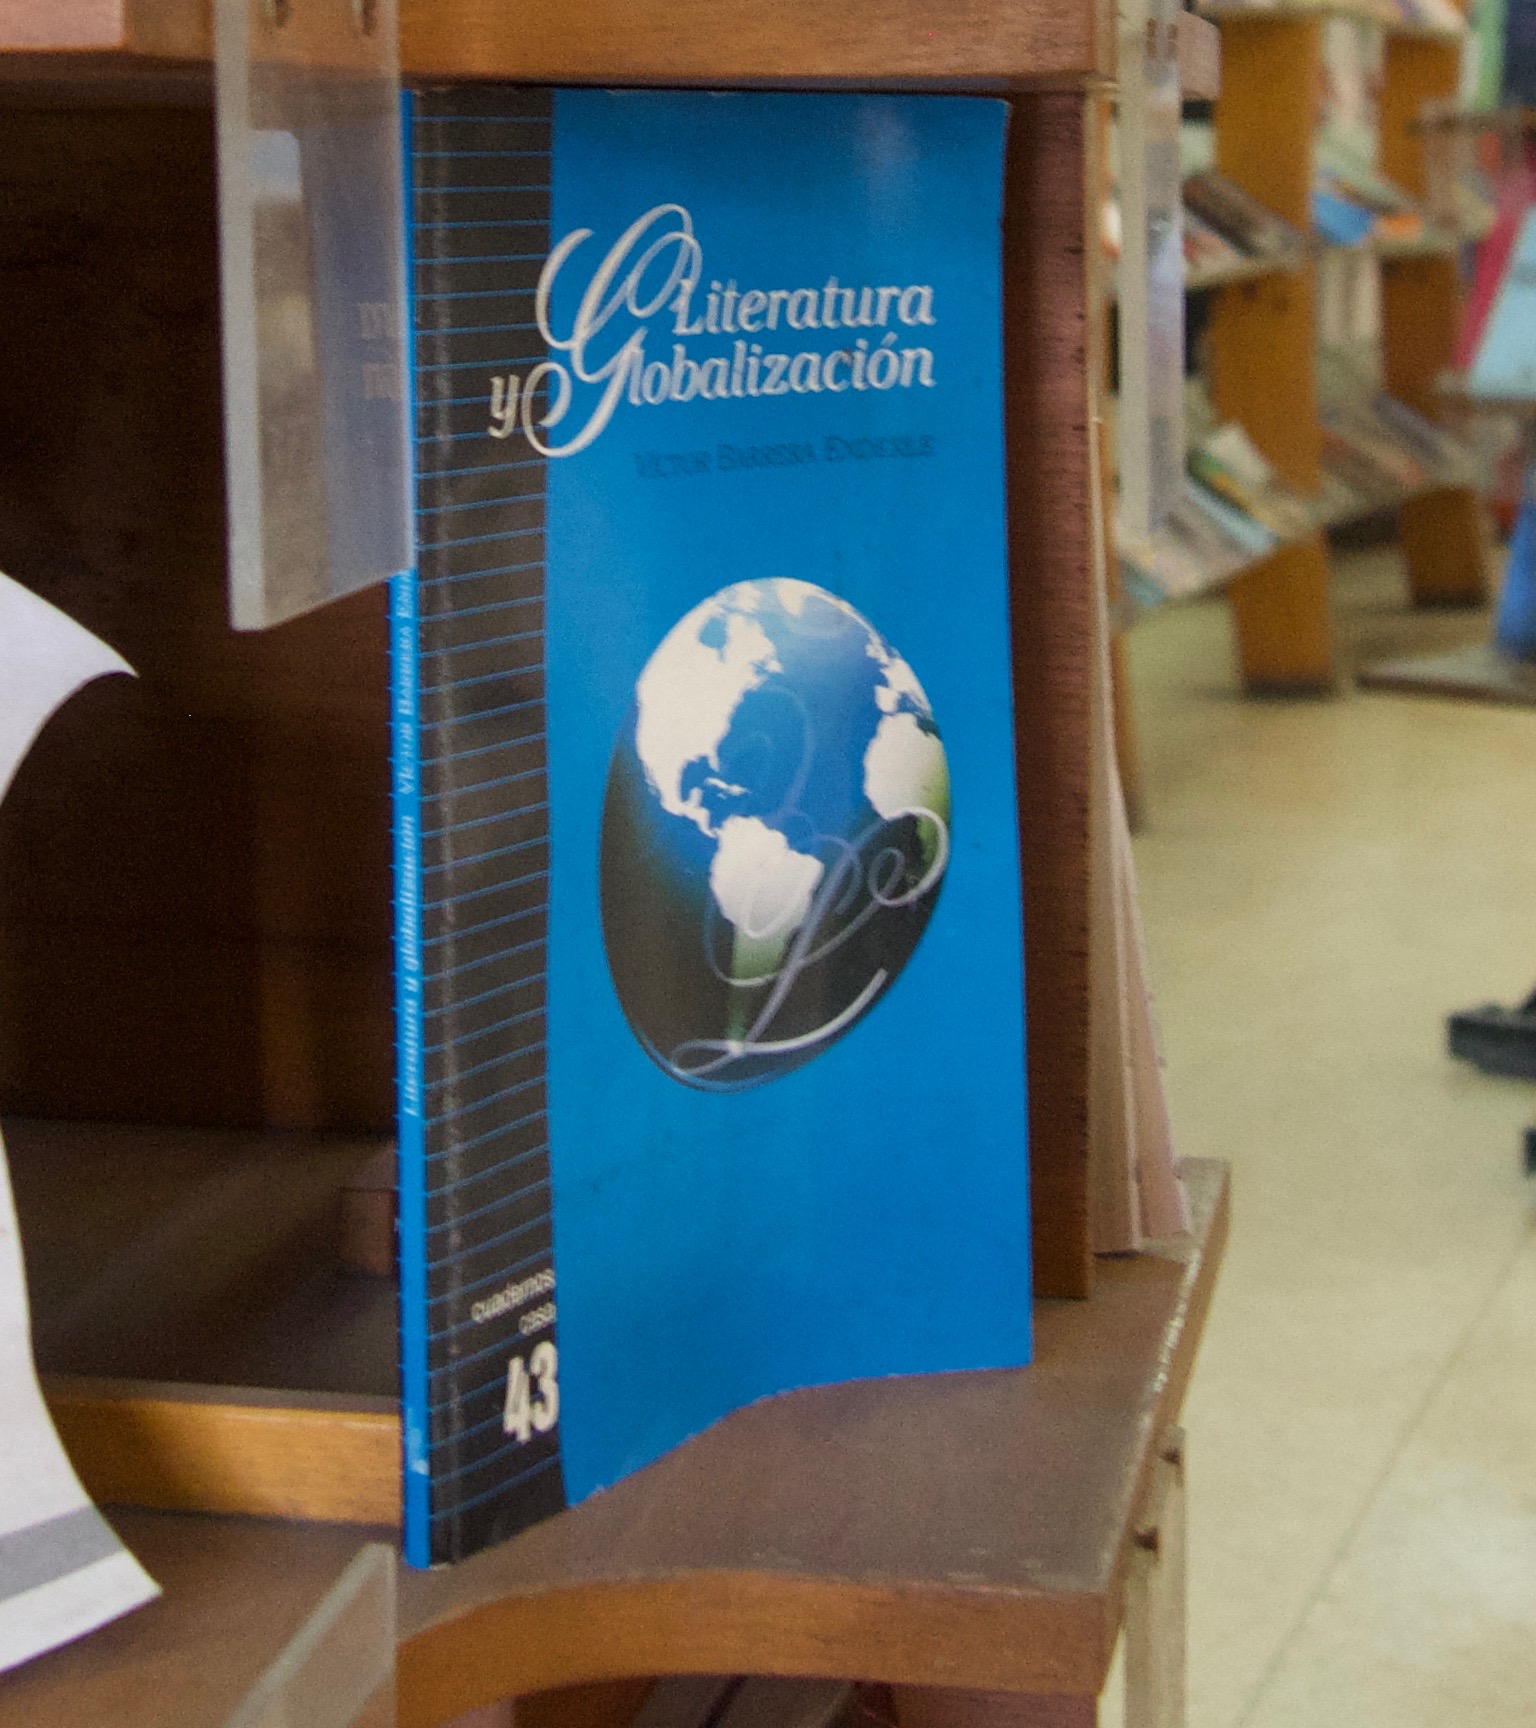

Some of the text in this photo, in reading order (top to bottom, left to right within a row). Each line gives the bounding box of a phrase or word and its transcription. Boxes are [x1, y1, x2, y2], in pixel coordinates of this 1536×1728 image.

[489, 203, 938, 458] y Globalización
[654, 257, 938, 337] Literatura
[502, 1340, 561, 1446] 43
